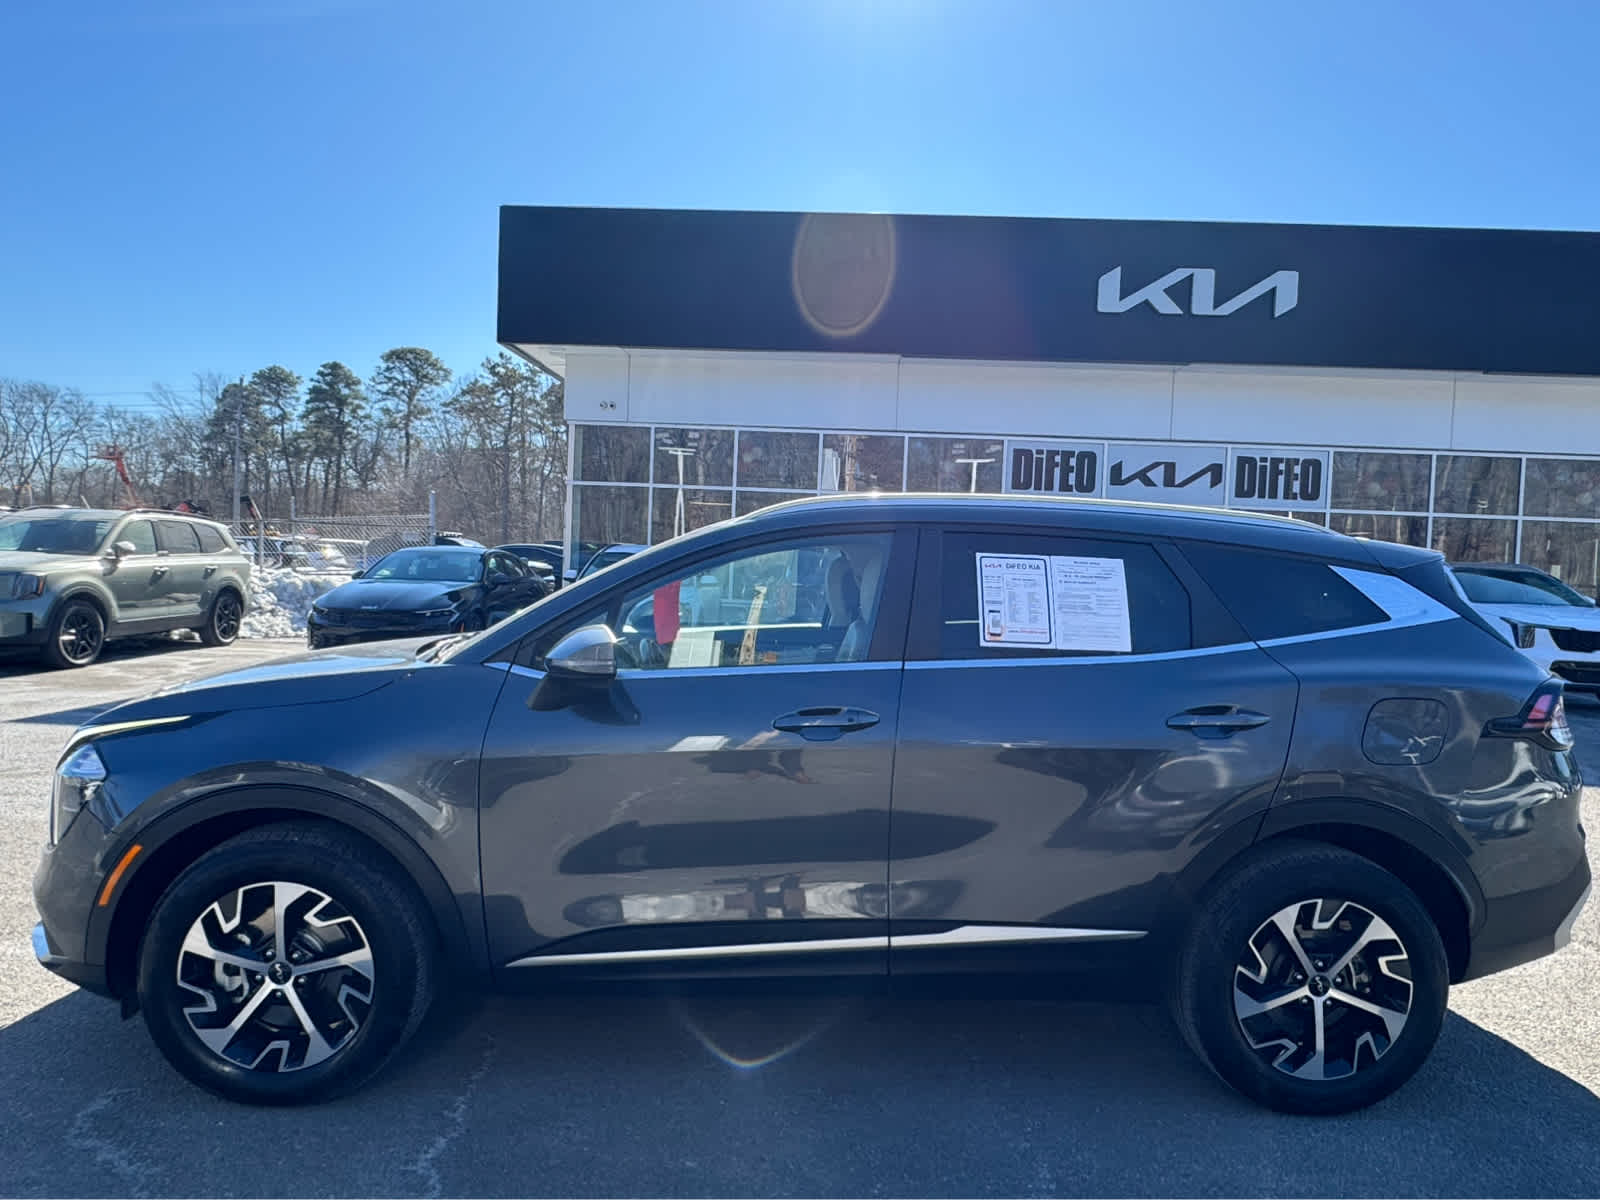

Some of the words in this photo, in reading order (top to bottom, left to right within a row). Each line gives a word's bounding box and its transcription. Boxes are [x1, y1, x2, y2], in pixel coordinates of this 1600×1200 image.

[1097, 266, 1299, 318] KIA
[1011, 449, 1097, 493] DiFEO
[1109, 460, 1223, 489] KIA
[1234, 456, 1322, 501] DiFEO
